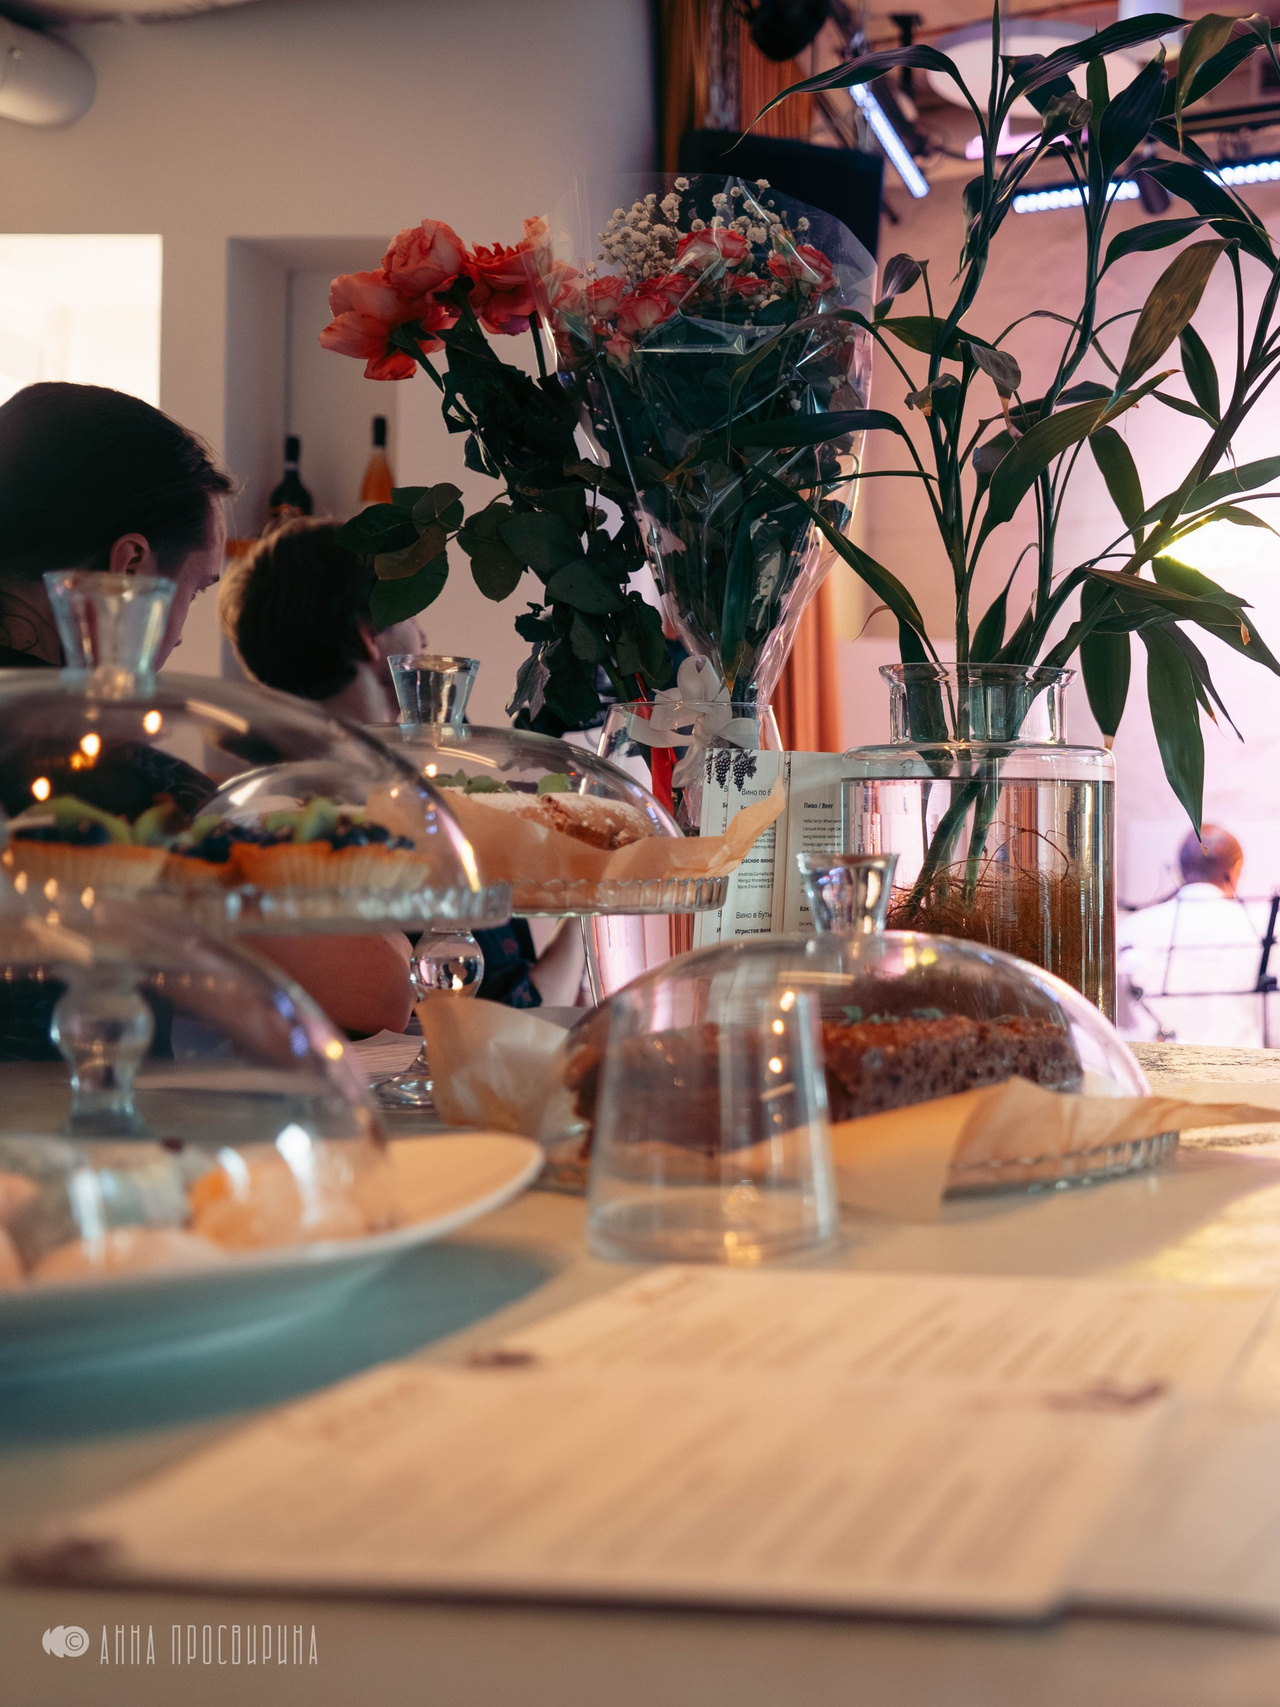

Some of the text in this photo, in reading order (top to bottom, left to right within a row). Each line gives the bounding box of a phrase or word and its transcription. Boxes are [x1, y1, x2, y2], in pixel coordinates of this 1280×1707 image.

[742, 788, 758, 796] Вино
[736, 911, 752, 919] Вино
[758, 910, 772, 920] буты
